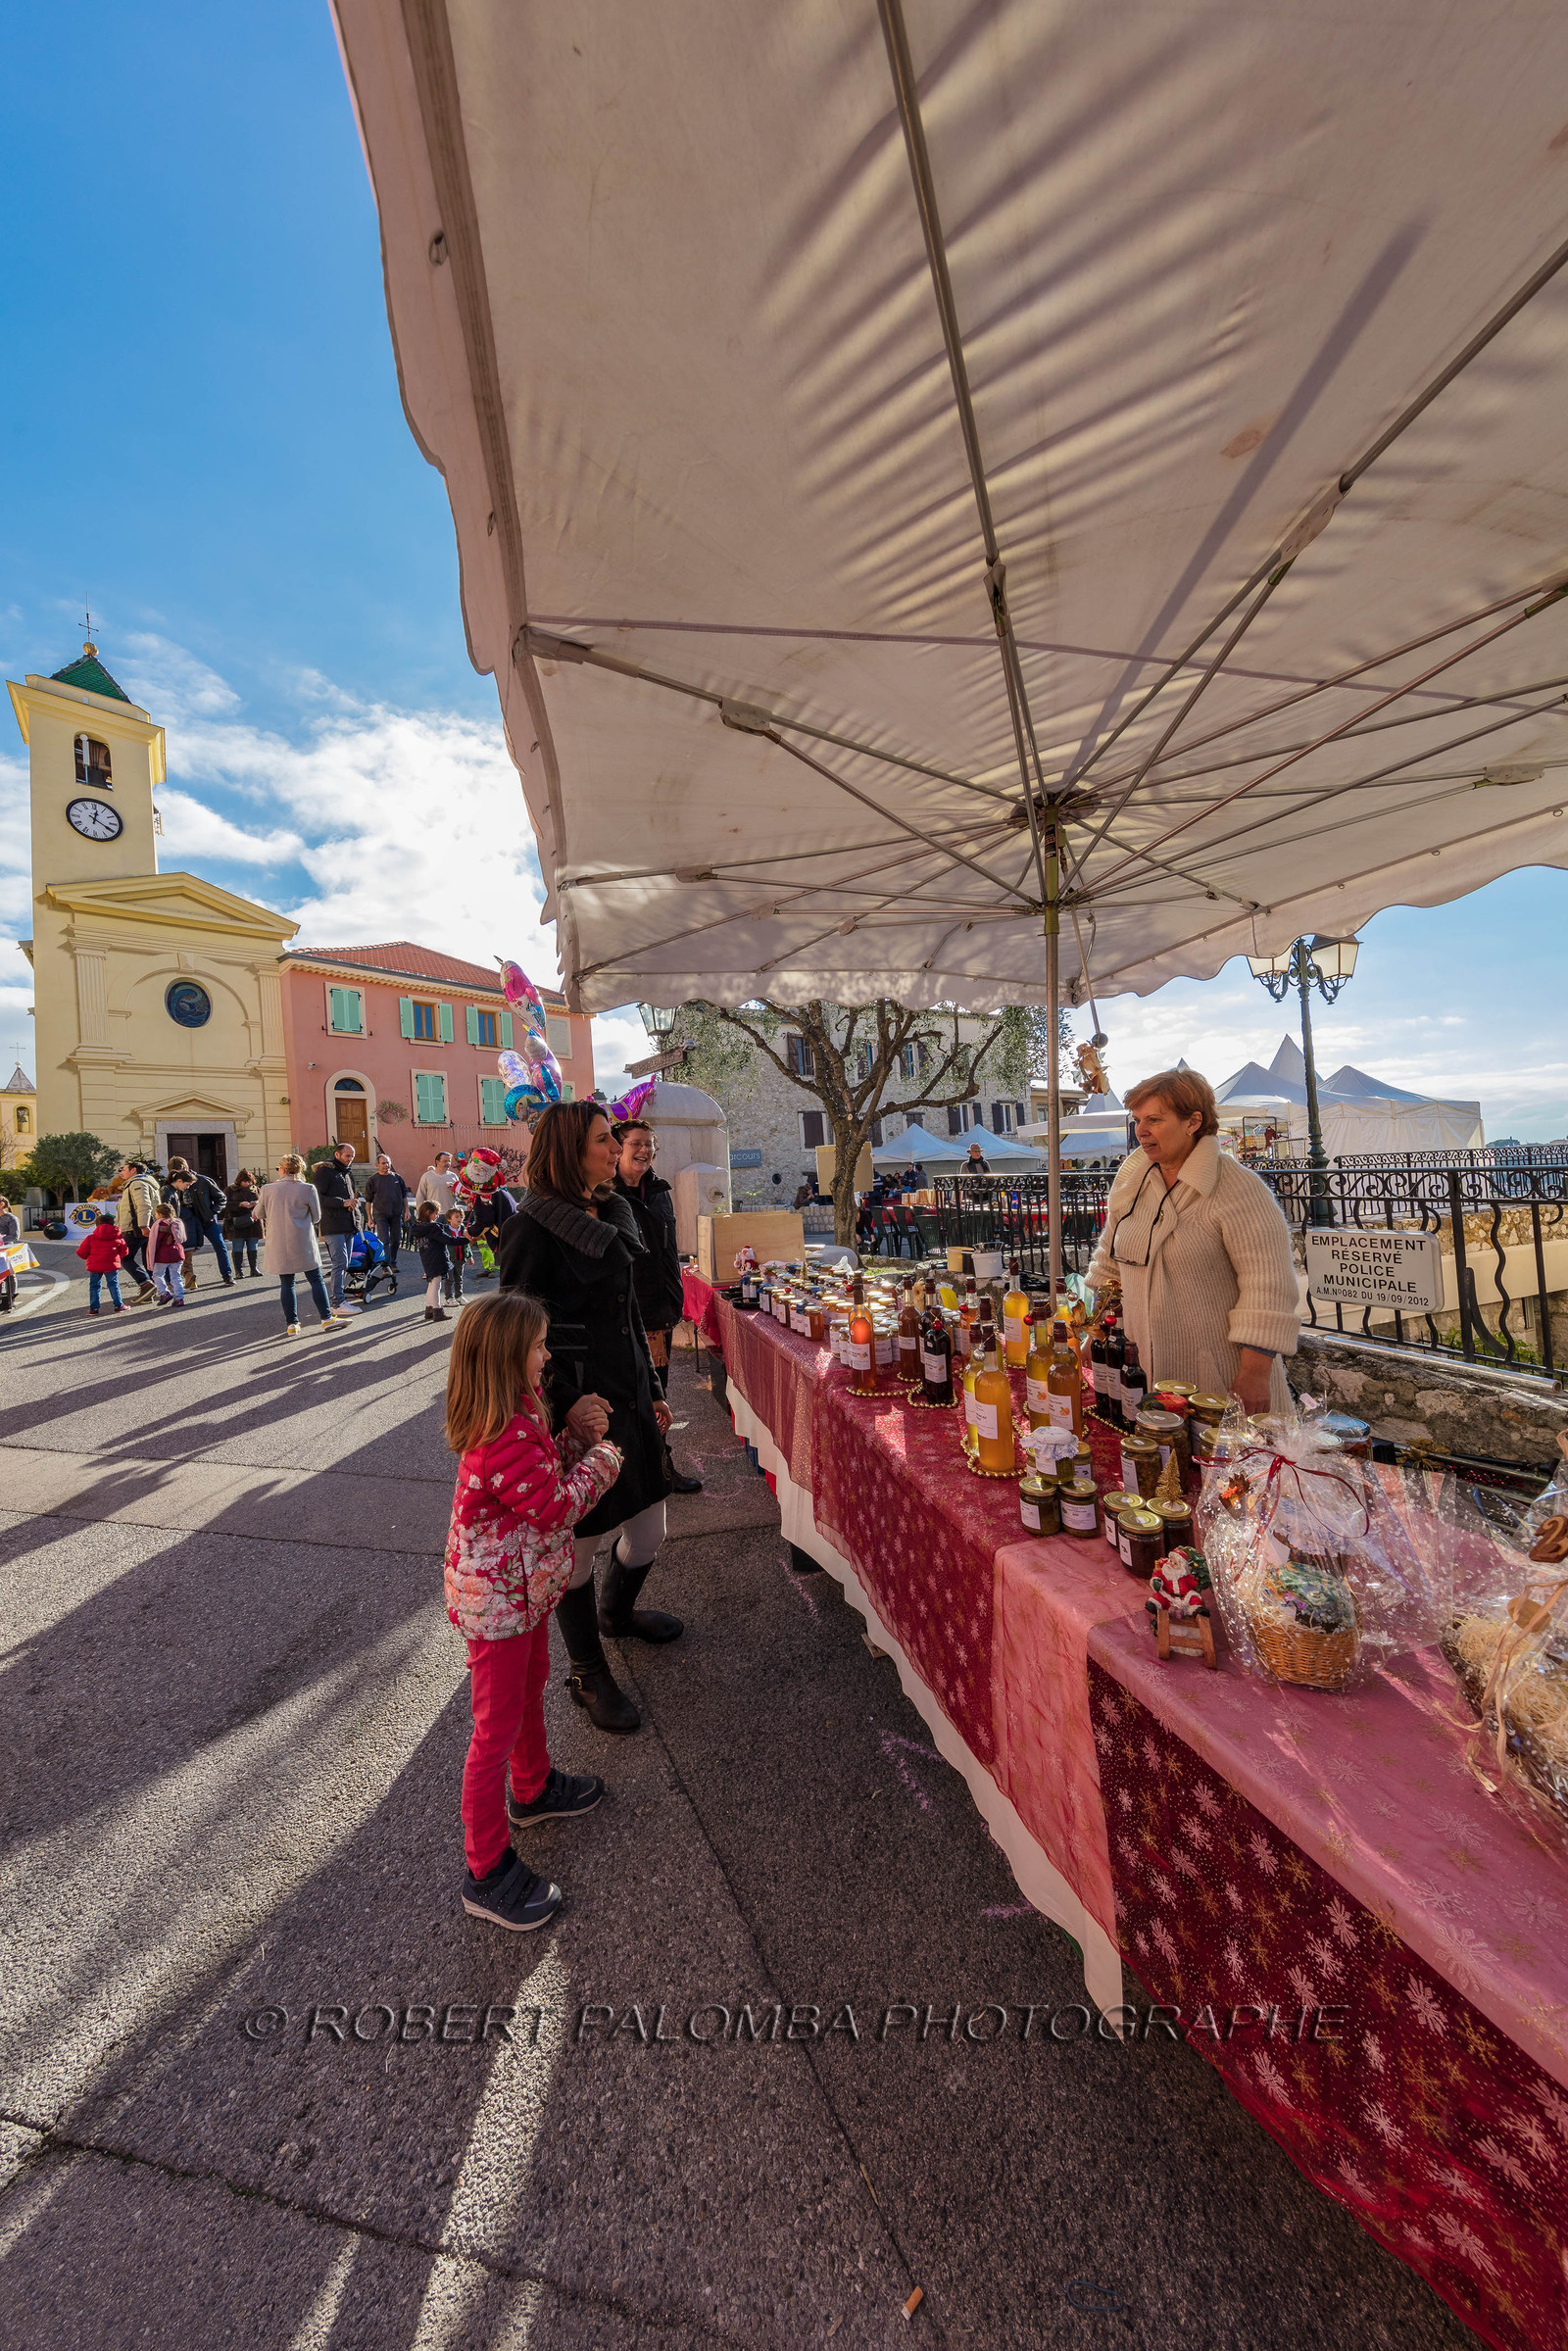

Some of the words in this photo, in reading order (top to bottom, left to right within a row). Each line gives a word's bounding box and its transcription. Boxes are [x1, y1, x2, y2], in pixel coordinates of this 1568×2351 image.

[1311, 1235, 1426, 1251] EMPLACEMENT
[1331, 1248, 1402, 1264] RÉSERVÉ
[1340, 1262, 1396, 1278] POLICE
[1323, 1274, 1417, 1294] MUNICIPALE
[1361, 1291, 1373, 1300] DU
[1376, 1293, 1429, 1307] 19/09/2012
